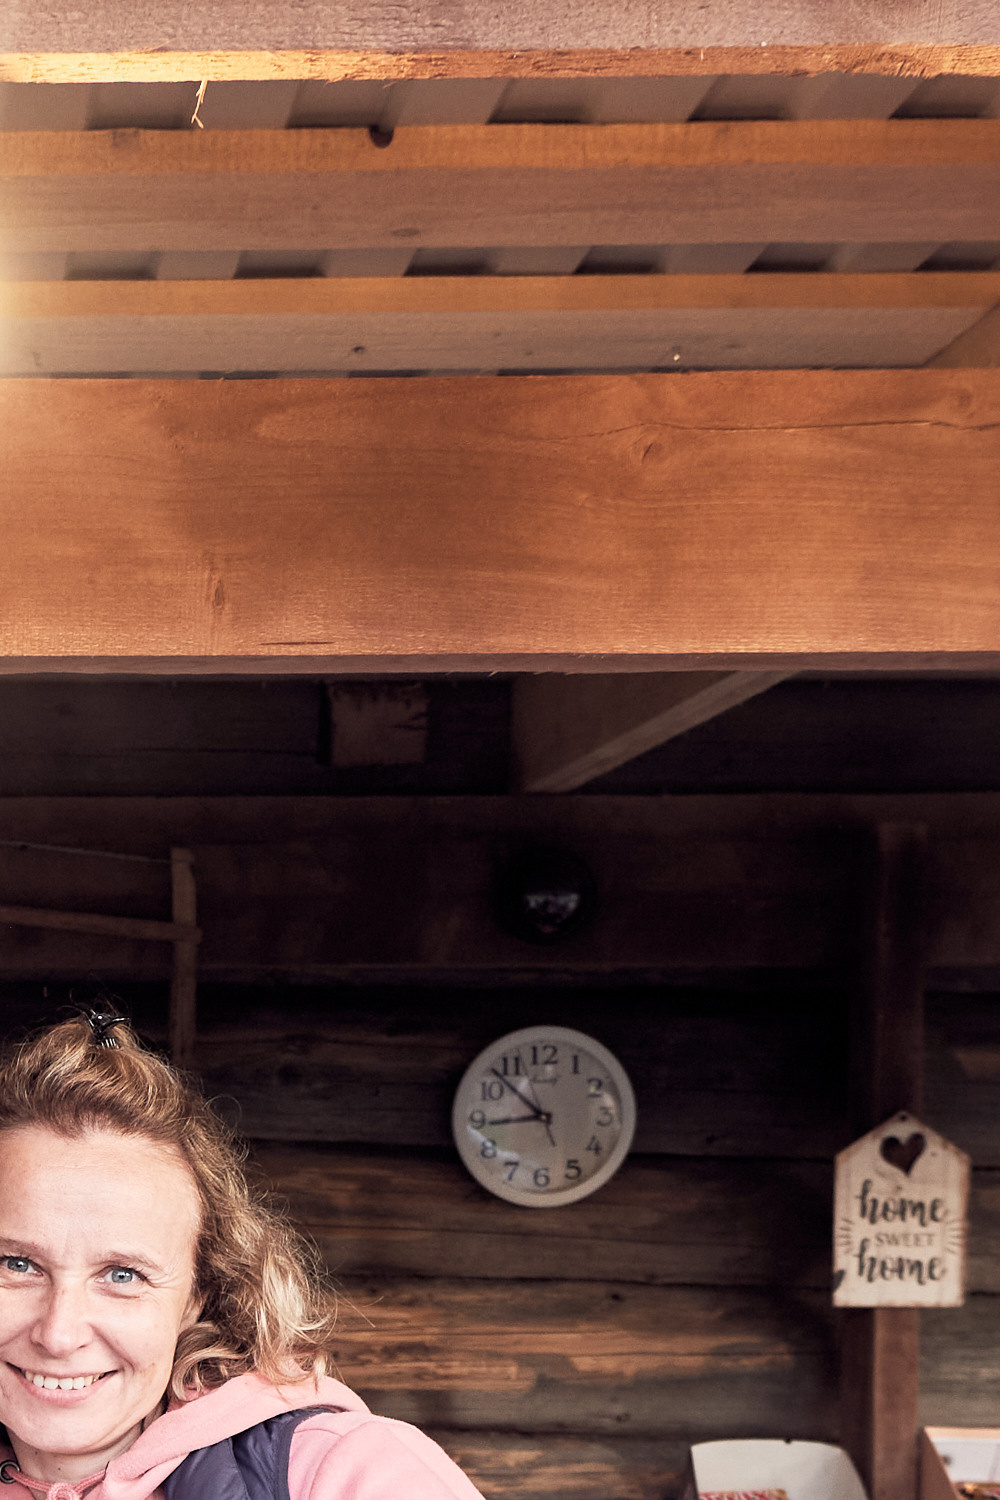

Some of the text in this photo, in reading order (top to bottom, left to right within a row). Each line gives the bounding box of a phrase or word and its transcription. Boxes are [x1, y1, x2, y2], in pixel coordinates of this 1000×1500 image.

[531, 1045, 558, 1065] 12
[572, 1055, 580, 1074] 1
[502, 1056, 520, 1076] 11
[481, 1081, 504, 1101] 10
[587, 1078, 603, 1098] 2
[469, 1110, 486, 1129] 9
[596, 1107, 613, 1126] 3
[480, 1139, 497, 1159] 8
[586, 1136, 602, 1155] 4
[503, 1161, 519, 1181] 7
[533, 1168, 550, 1187] 6
[565, 1159, 581, 1180] 5
[855, 1179, 948, 1227] home
[875, 1233, 935, 1247] SWEET
[853, 1238, 948, 1285] home
